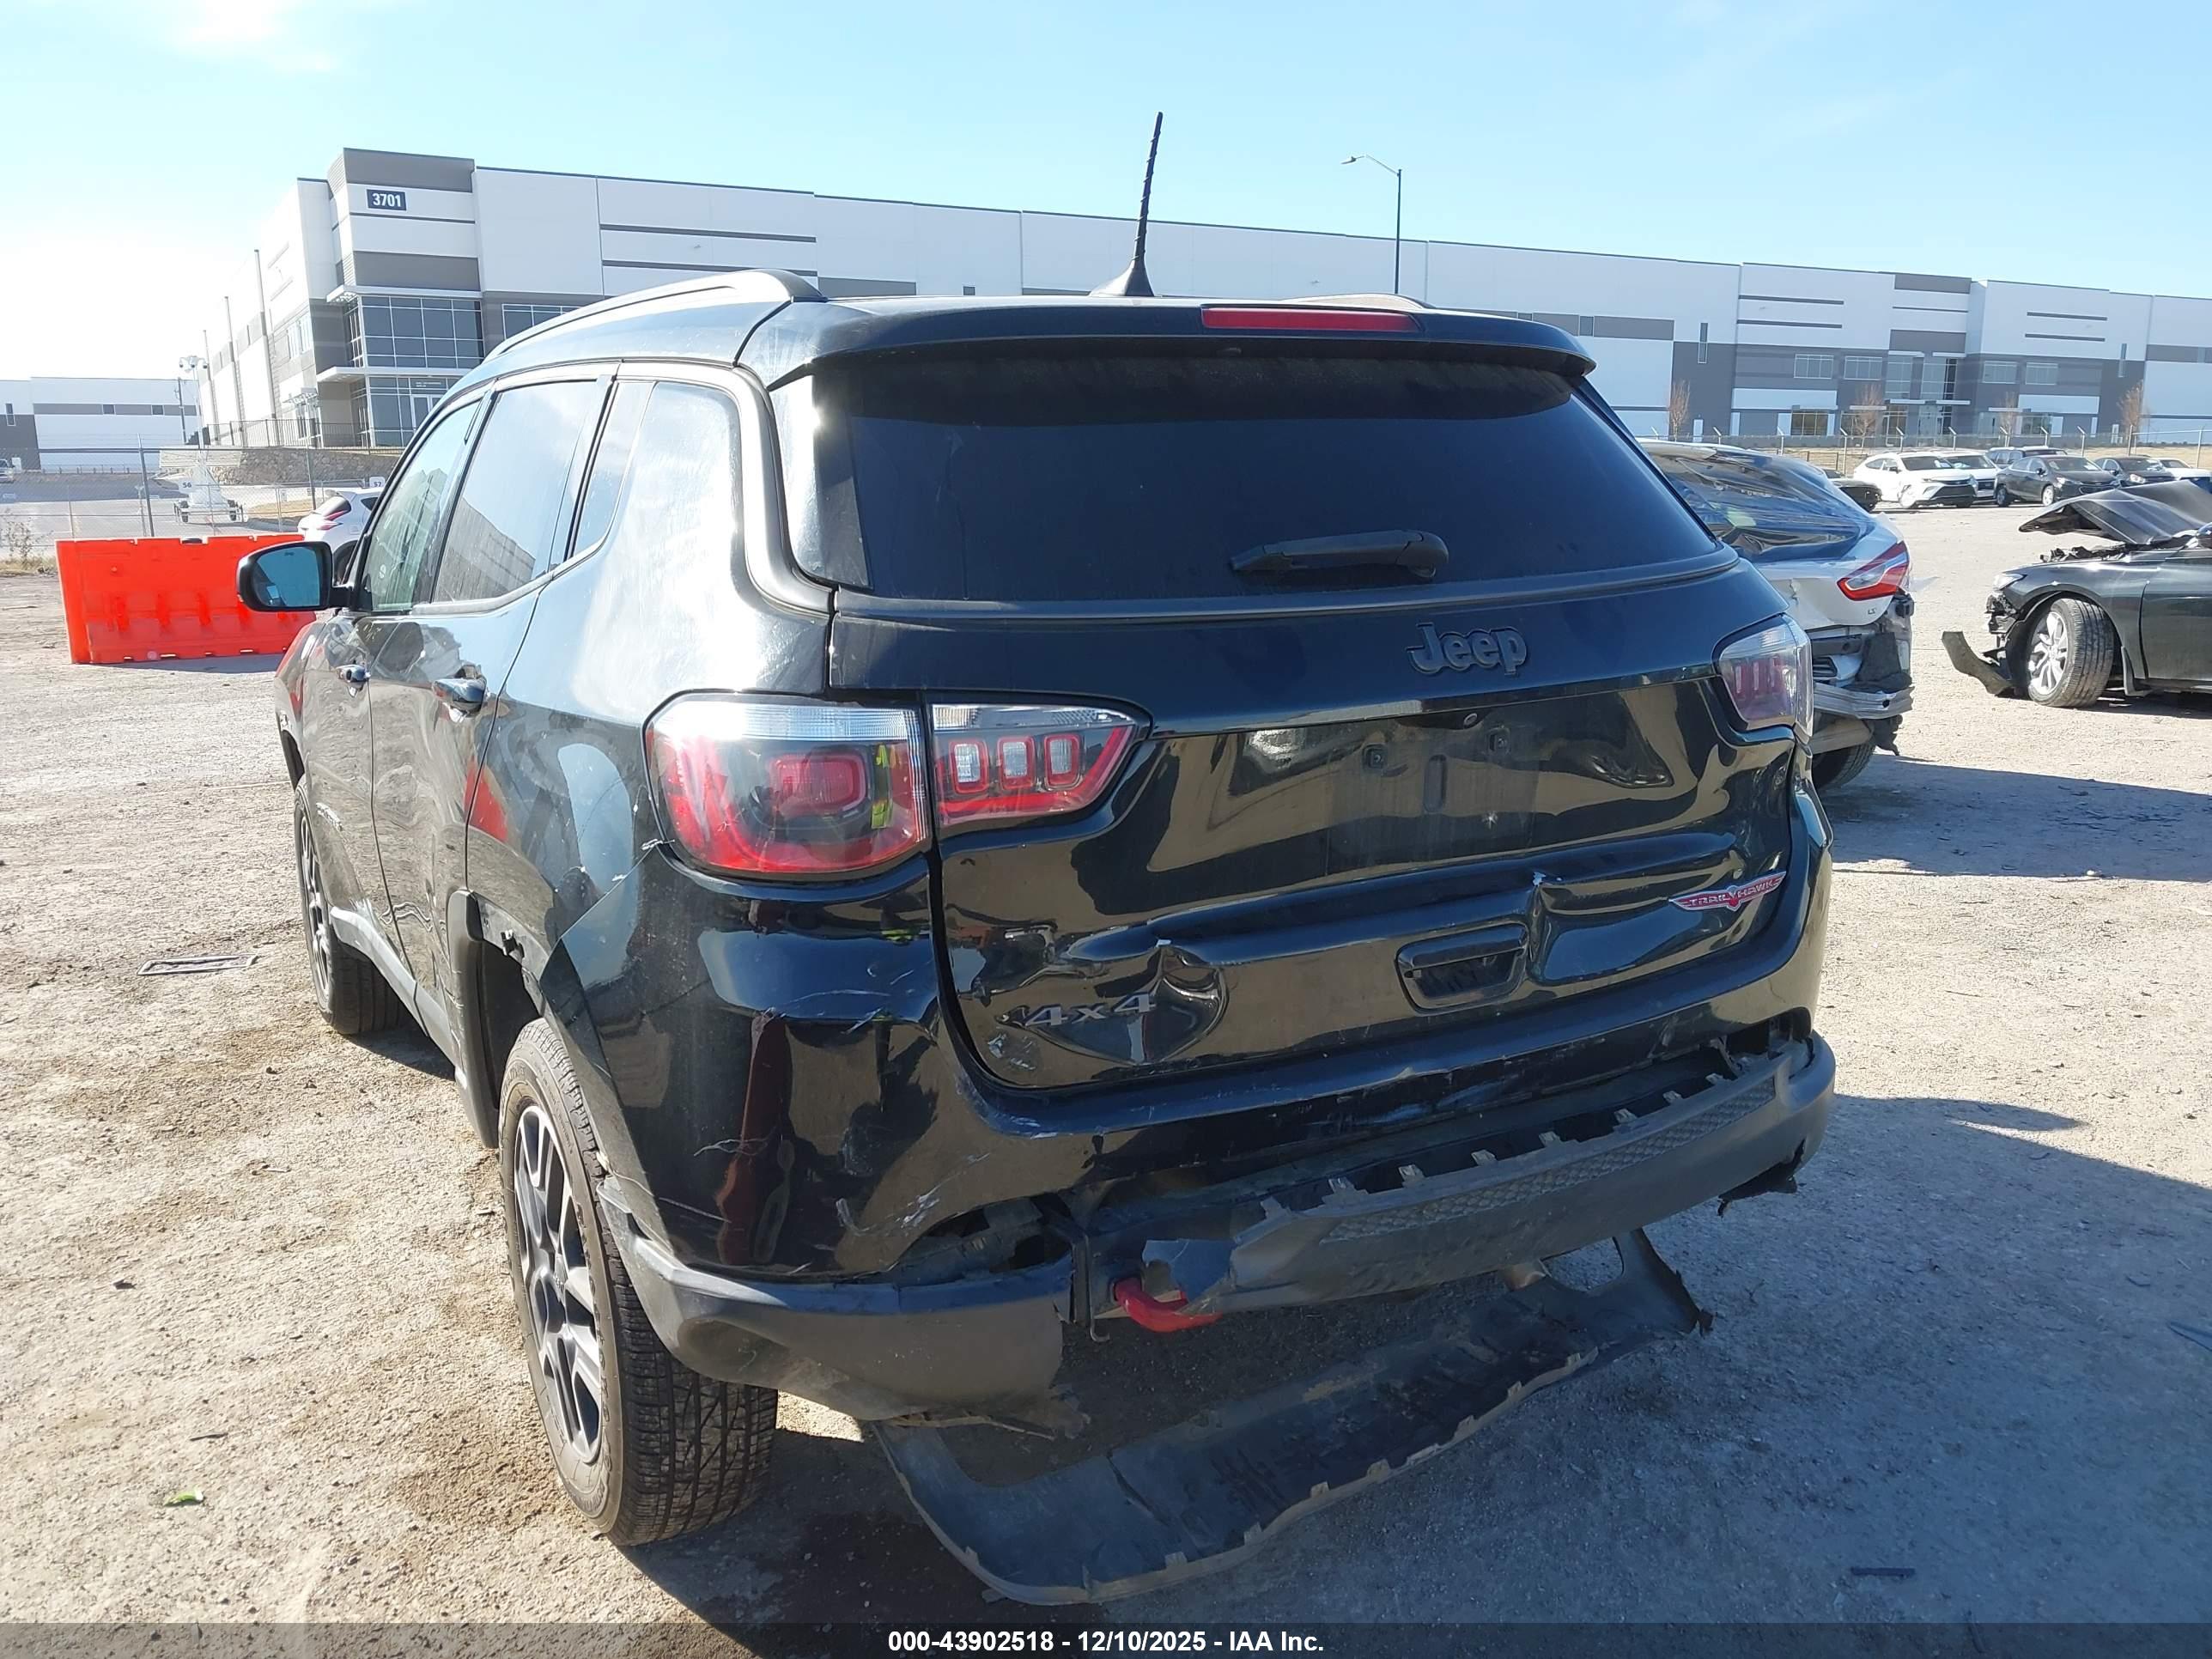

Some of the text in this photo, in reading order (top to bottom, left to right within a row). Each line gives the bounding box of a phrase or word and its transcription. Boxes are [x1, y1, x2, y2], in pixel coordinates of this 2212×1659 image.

[372, 192, 401, 207] 3701
[1406, 622, 1528, 676] Jeep
[1025, 992, 1156, 1027] 4x4
